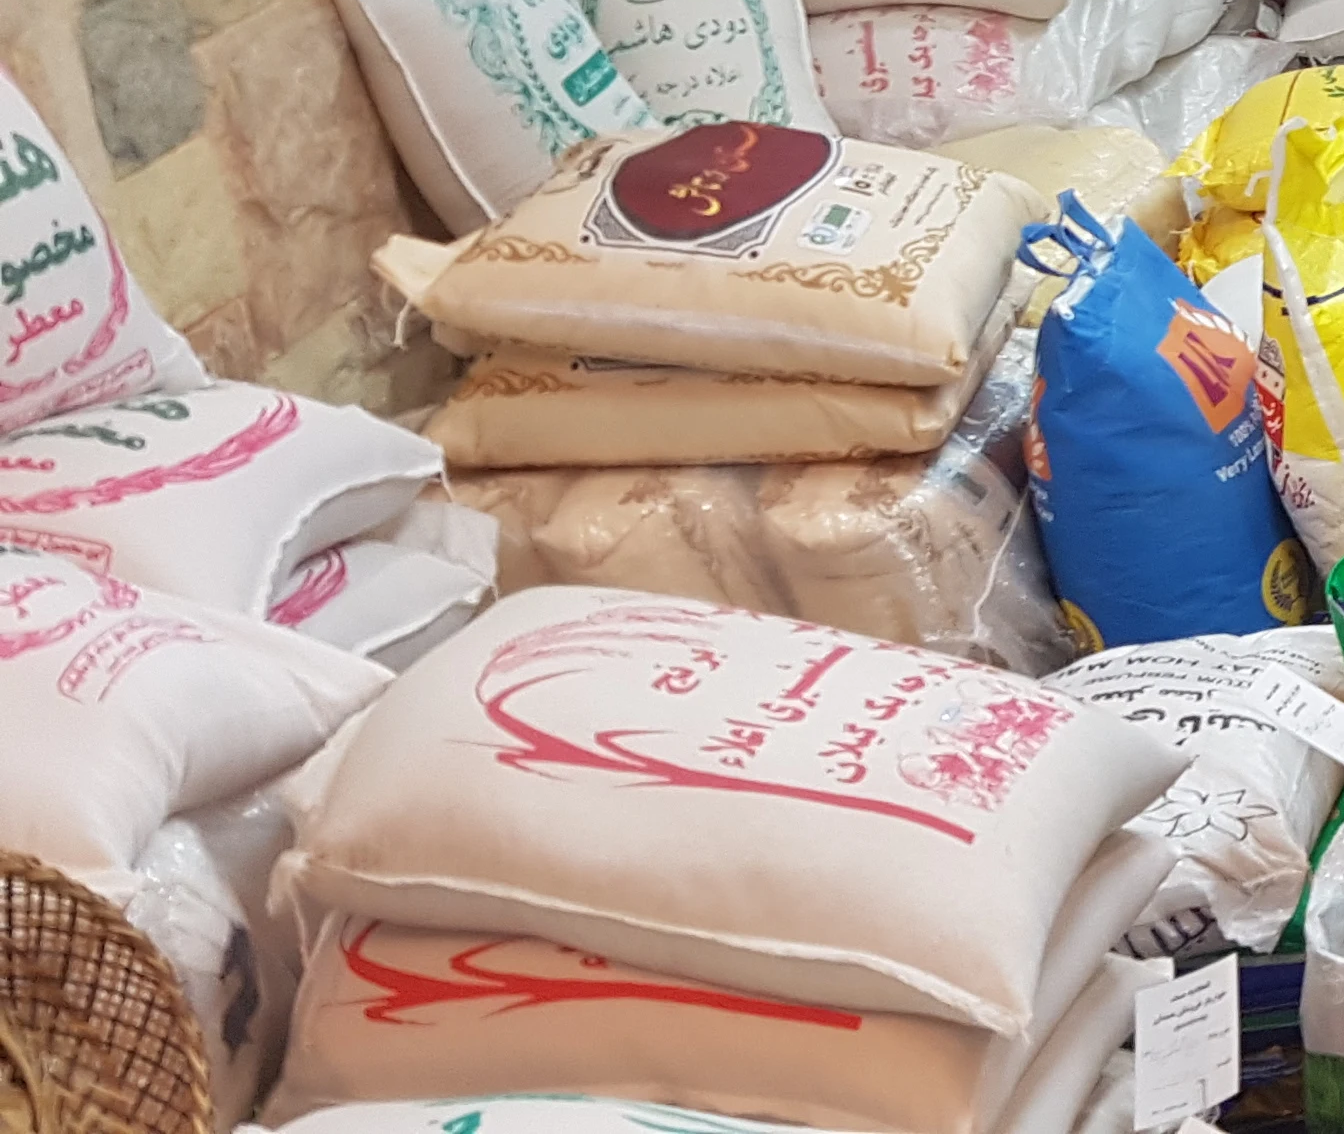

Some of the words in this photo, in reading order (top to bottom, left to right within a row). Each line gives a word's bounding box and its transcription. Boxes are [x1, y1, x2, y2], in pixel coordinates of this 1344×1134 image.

[684, 17, 749, 50] دودی
[0, 218, 94, 305] مخصو
[6, 297, 85, 363] معطر
[1215, 456, 1248, 483] Very
[651, 646, 728, 695] برنج
[817, 722, 887, 784] گیلان
